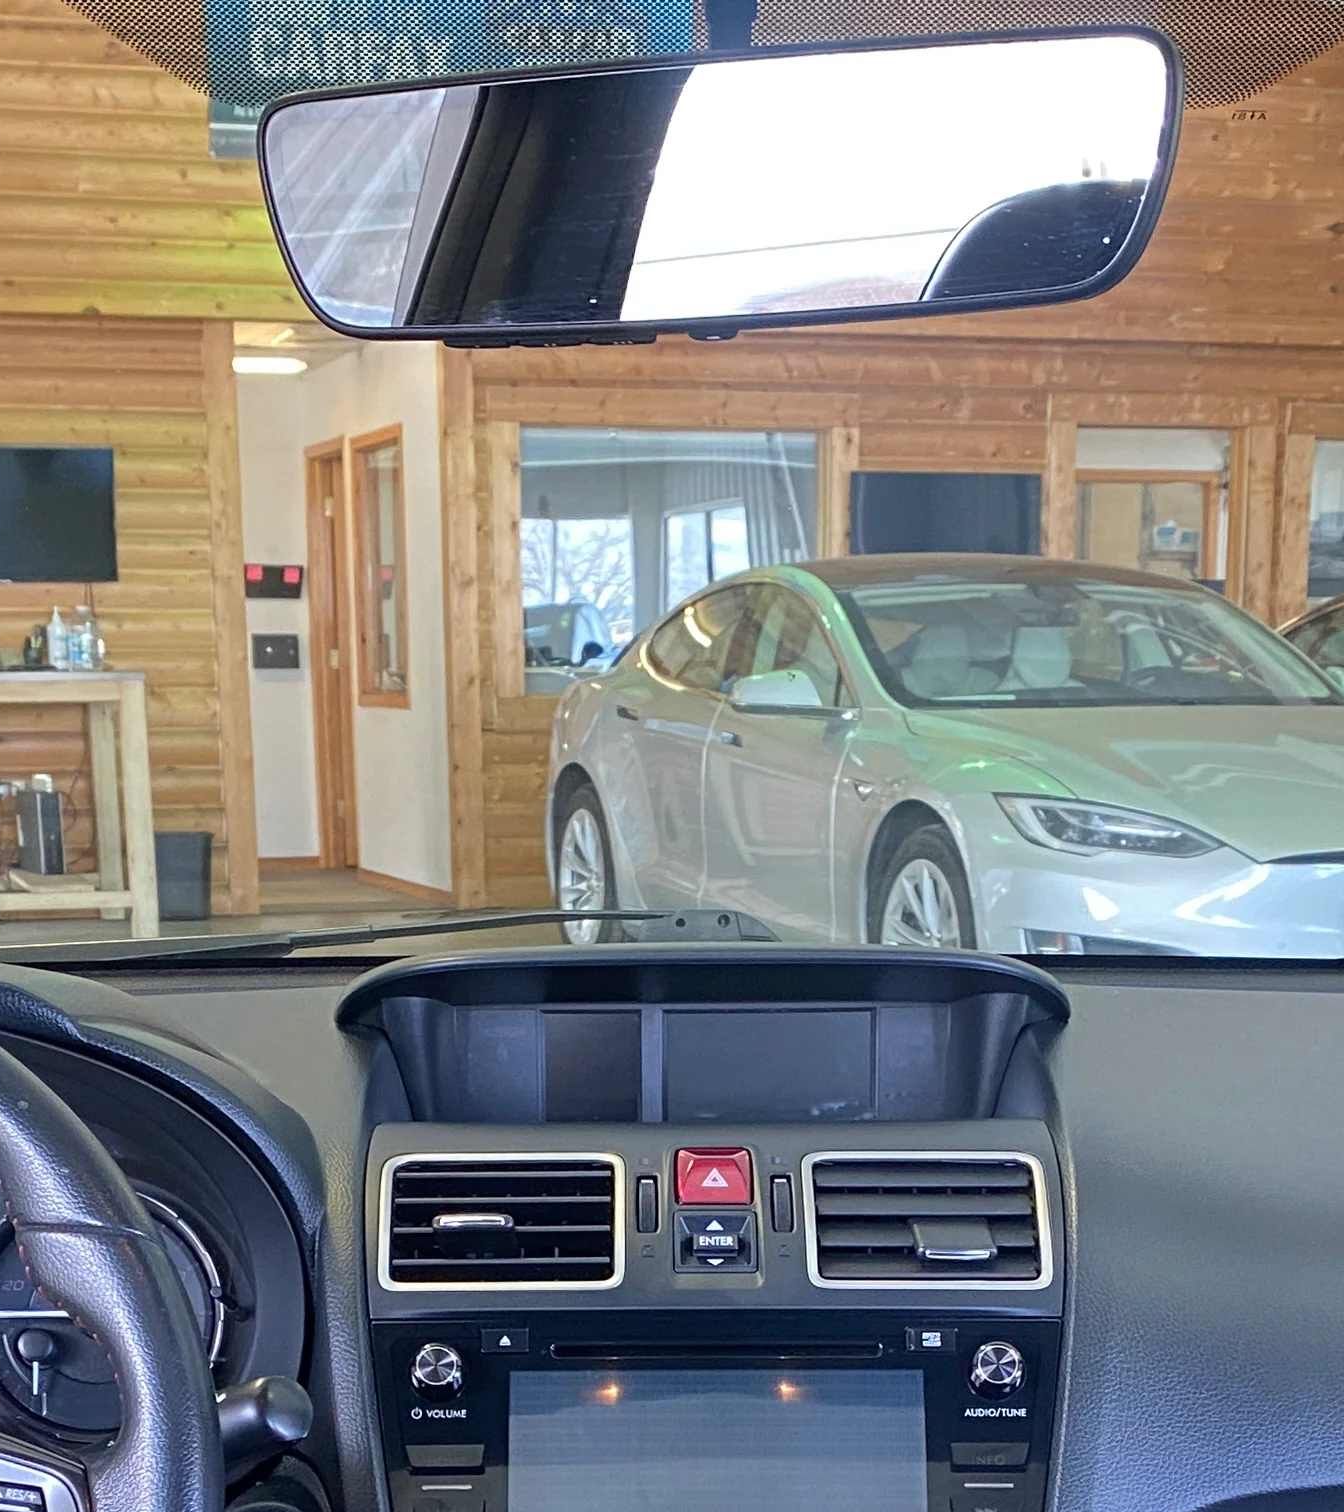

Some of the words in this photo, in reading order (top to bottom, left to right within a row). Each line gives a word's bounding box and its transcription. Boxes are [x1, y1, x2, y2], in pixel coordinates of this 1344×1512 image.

[250, 26, 455, 81] CARFAX
[699, 1235, 734, 1246] ENTER
[425, 1409, 467, 1419] VOLUME
[964, 1407, 1027, 1418] AUDIO/TUNE
